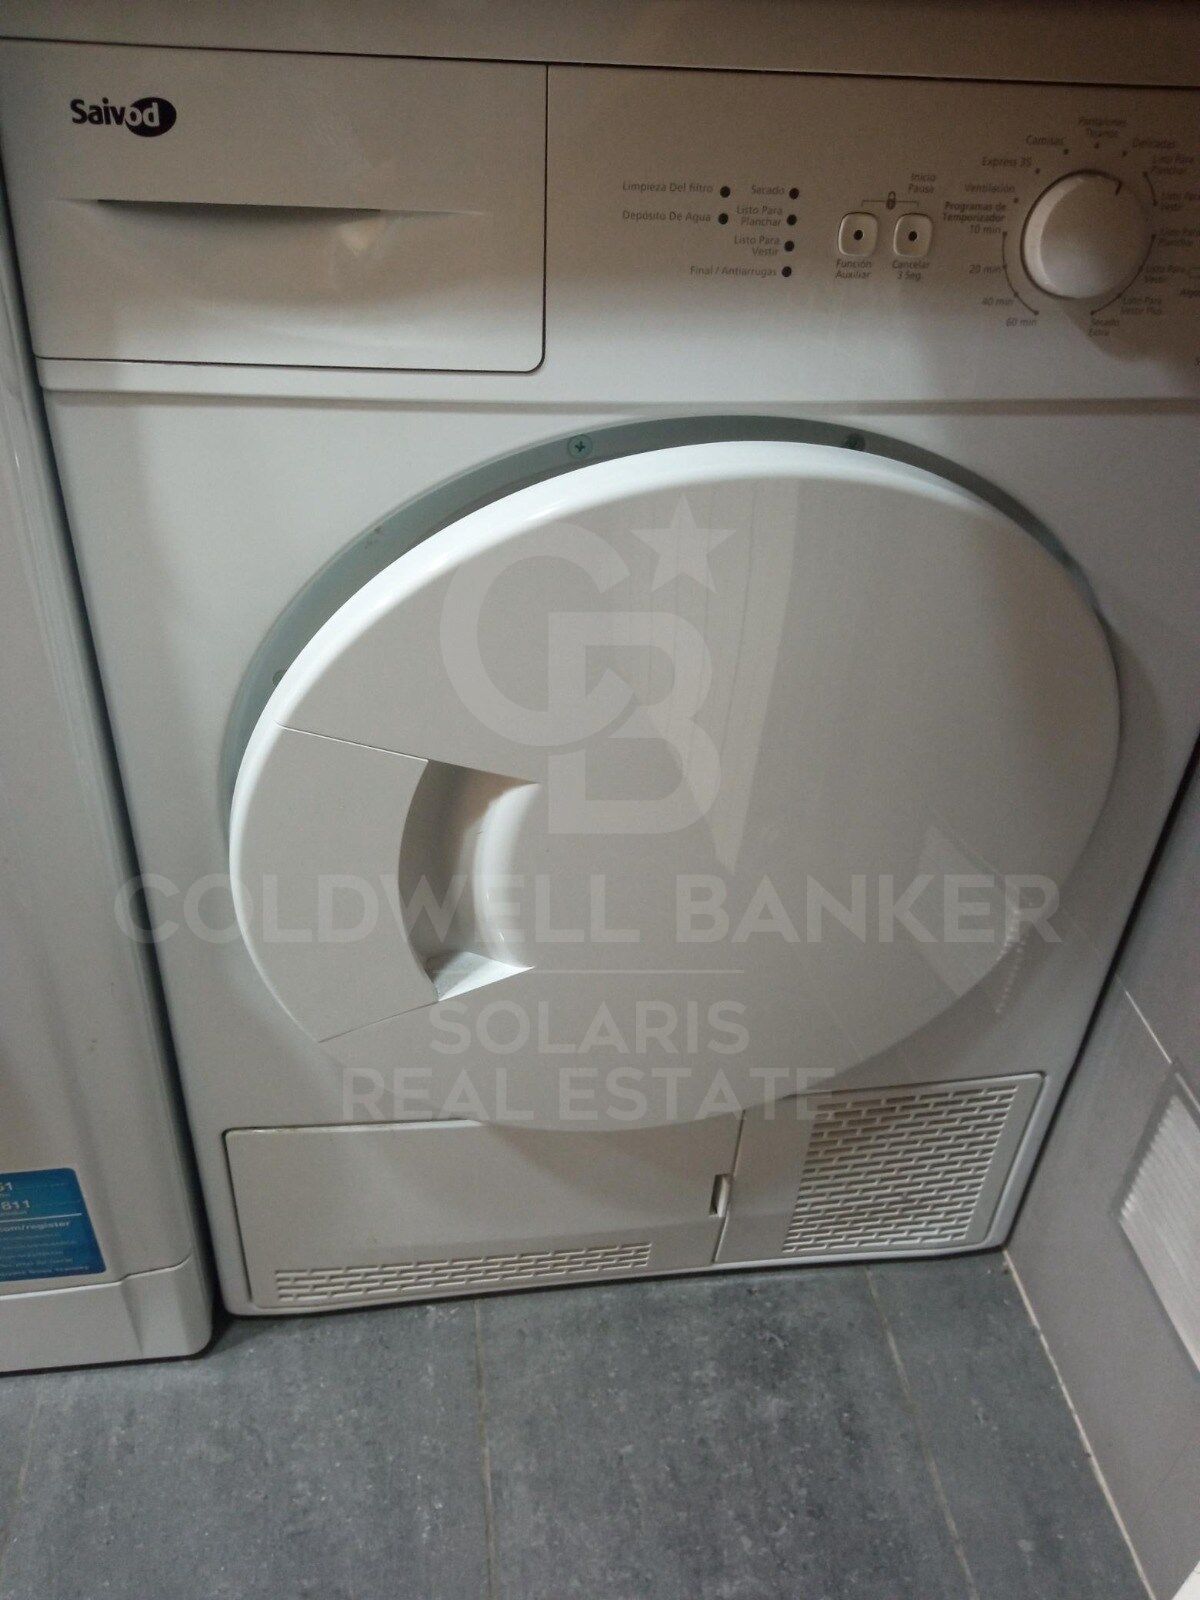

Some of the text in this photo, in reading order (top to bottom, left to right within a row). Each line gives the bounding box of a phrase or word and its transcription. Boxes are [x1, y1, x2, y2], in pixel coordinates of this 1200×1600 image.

[70, 97, 168, 130] Saivod
[1025, 134, 1064, 146] Camisas
[981, 156, 1018, 168] Express
[911, 172, 936, 183] Inicio
[622, 181, 667, 194] Limpieza
[669, 182, 686, 193] Del
[751, 184, 785, 195] Secado
[907, 183, 935, 194] Pausa
[736, 205, 784, 215] Listo Para
[945, 201, 1006, 213] Programas de
[669, 211, 682, 222] De
[685, 212, 711, 224] Agua
[740, 216, 782, 227] Planchar
[943, 212, 1005, 223] Temporizador
[970, 224, 1001, 234] 10 min
[734, 235, 780, 246] Listo Para
[752, 246, 779, 257] Vestir
[836, 258, 931, 270] Función Cancelar
[968, 264, 1002, 275] 20 min
[690, 265, 713, 276] Final
[720, 266, 778, 279] Antiarrugas
[834, 269, 871, 280] Auxiliar
[981, 296, 1014, 306] 40 min
[1006, 316, 1037, 327] 60 min
